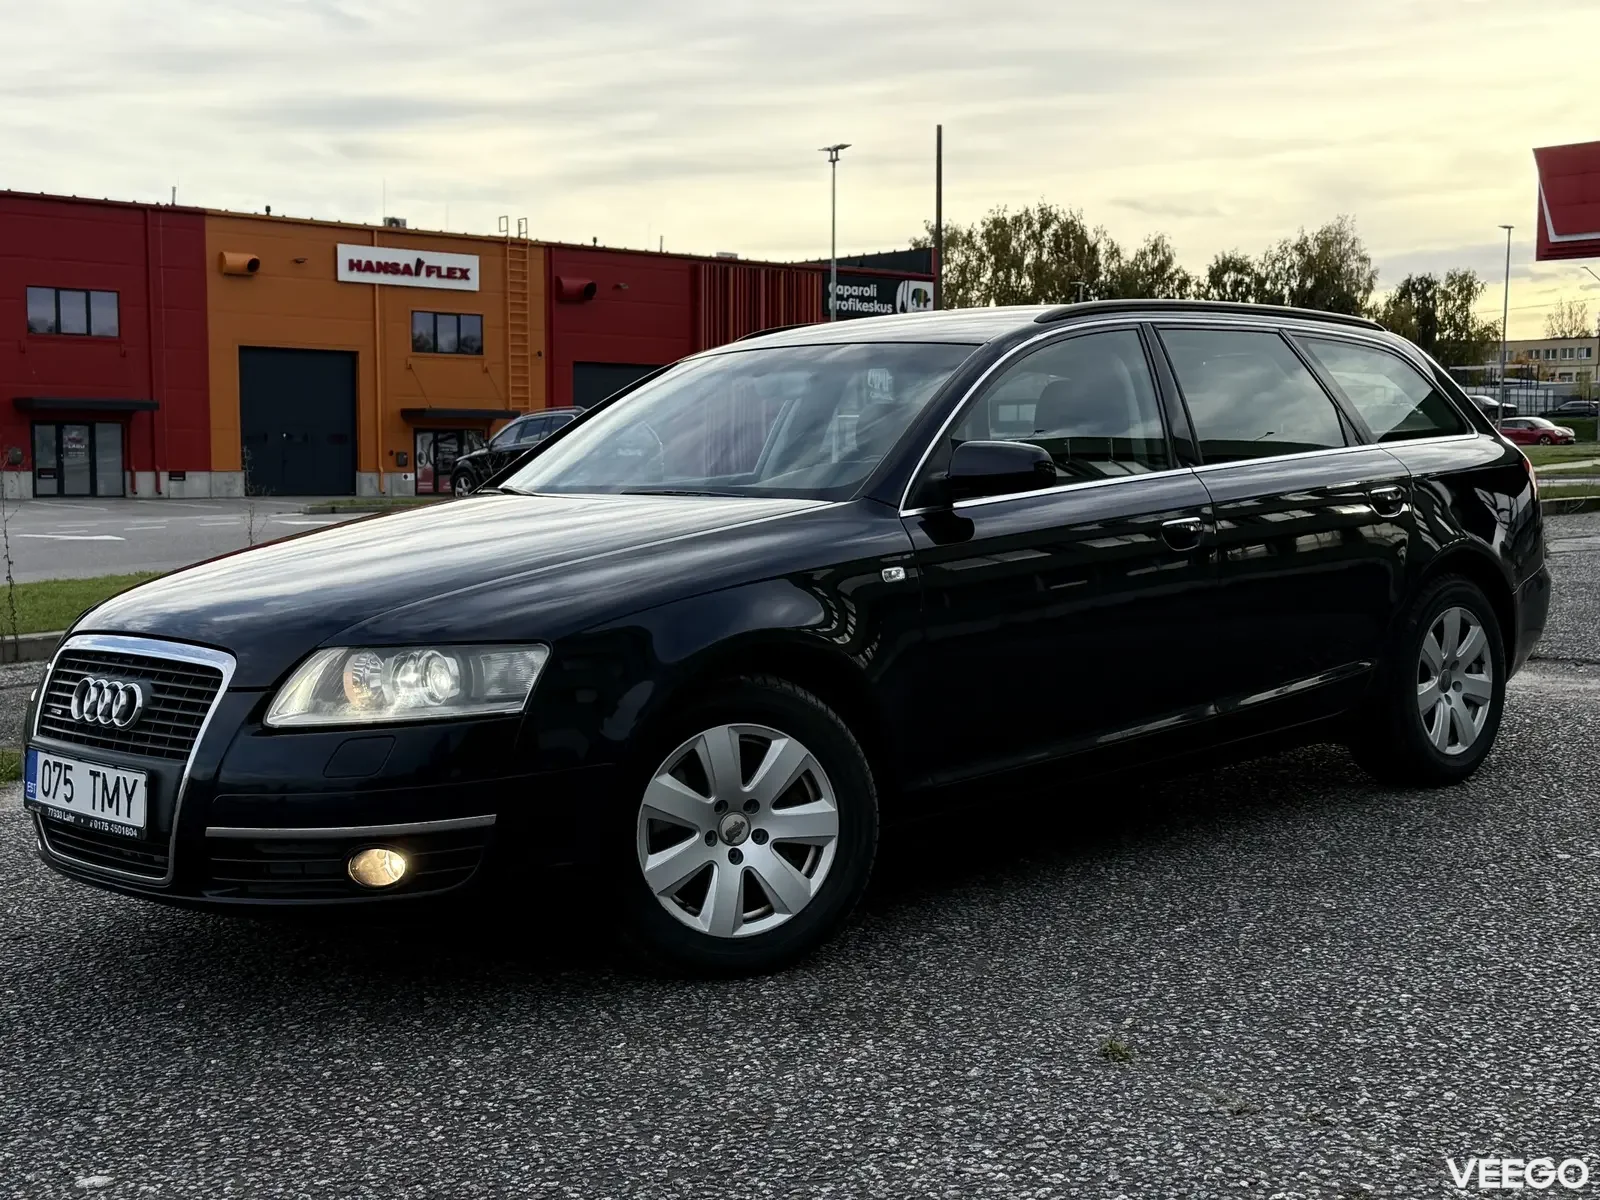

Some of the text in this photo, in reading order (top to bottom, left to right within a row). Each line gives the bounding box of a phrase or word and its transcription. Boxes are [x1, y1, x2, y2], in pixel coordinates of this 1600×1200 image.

[348, 258, 470, 281] HANSA FLEX
[41, 759, 74, 803] 075
[89, 769, 138, 818] TMY
